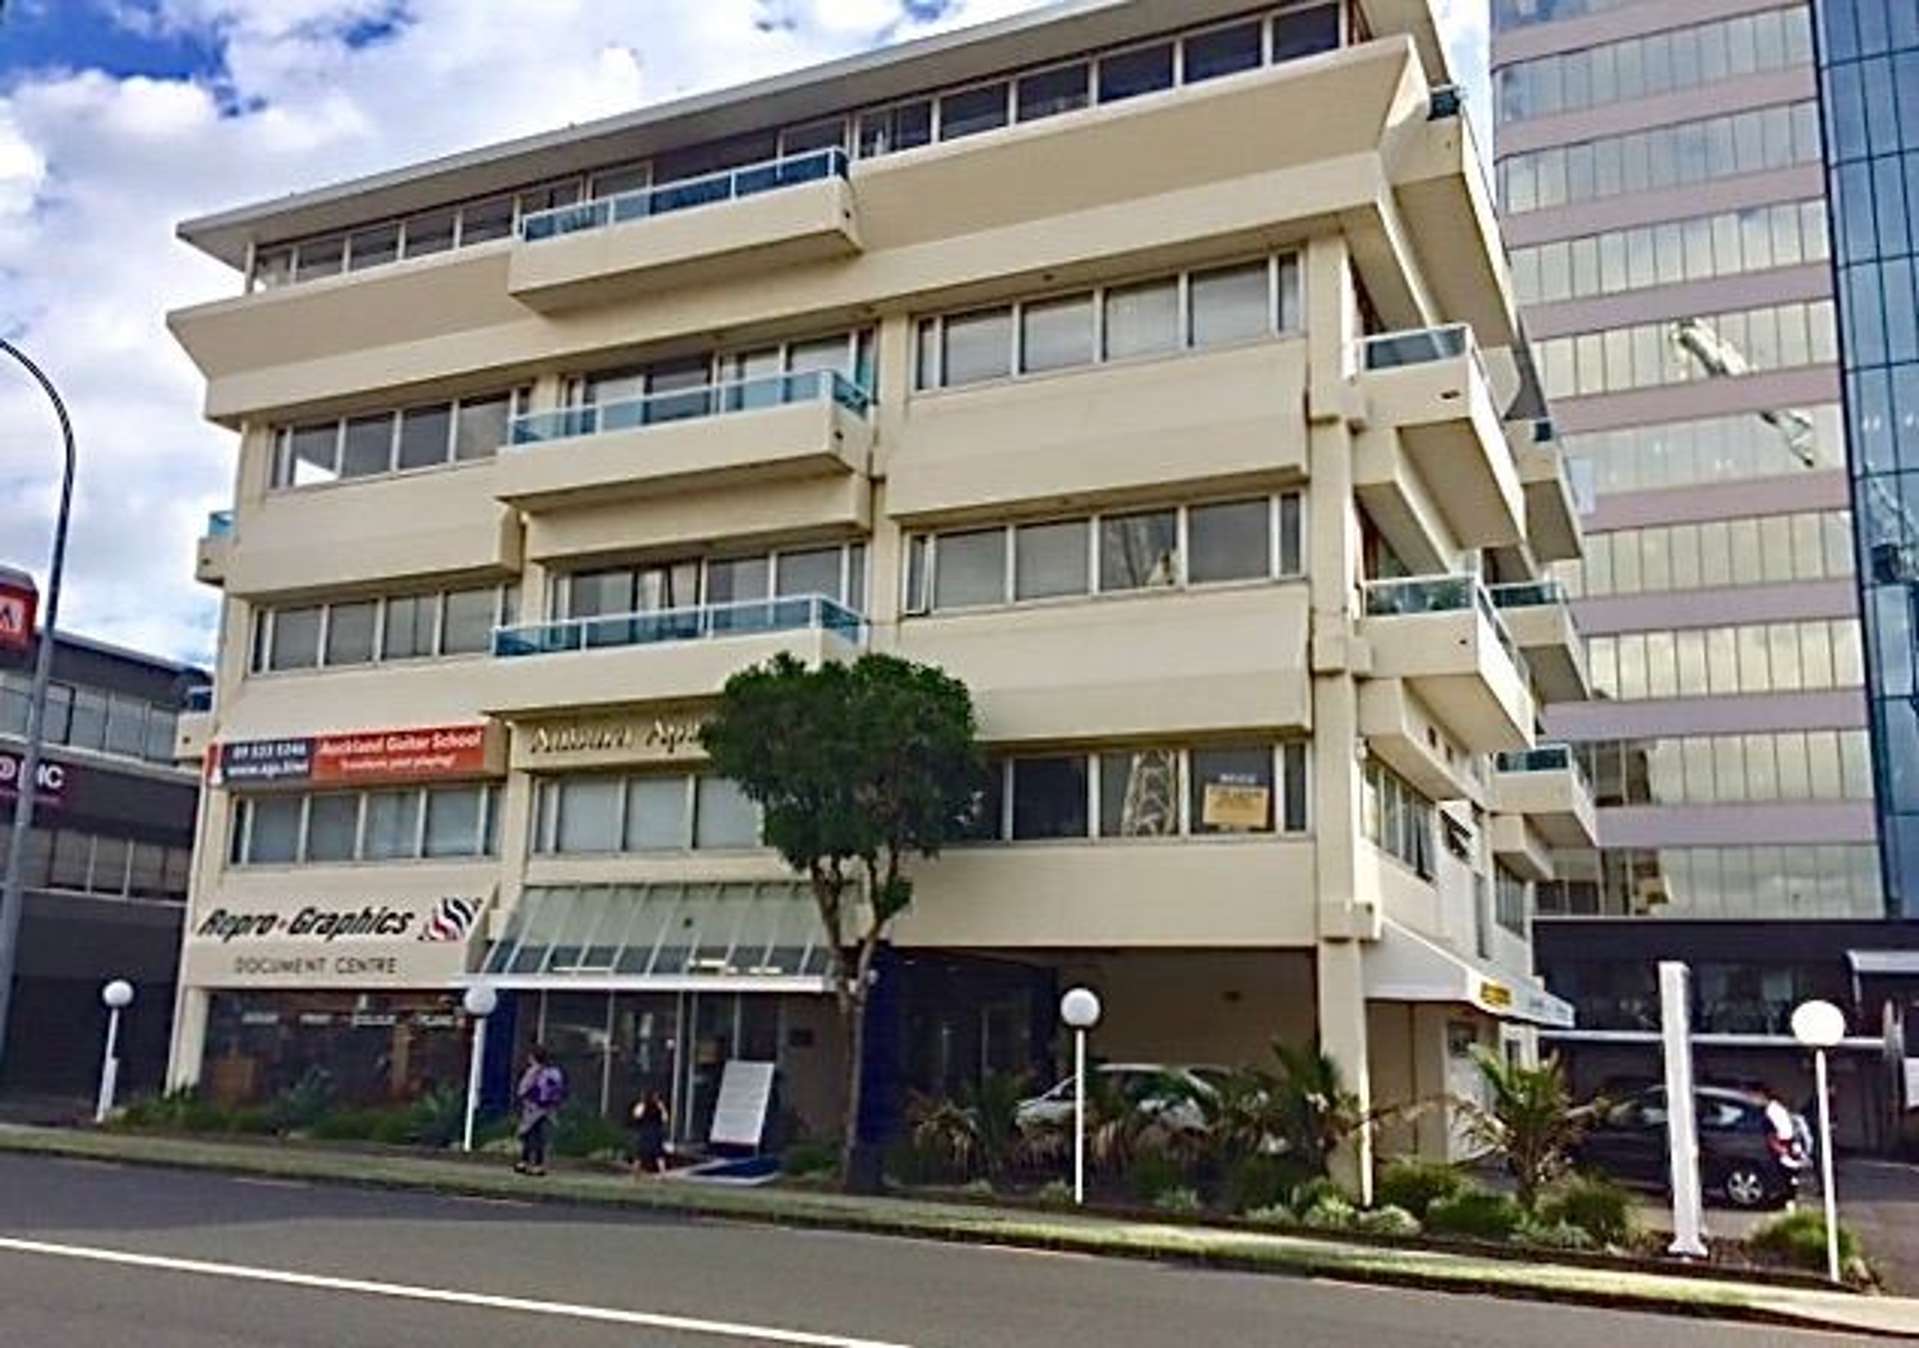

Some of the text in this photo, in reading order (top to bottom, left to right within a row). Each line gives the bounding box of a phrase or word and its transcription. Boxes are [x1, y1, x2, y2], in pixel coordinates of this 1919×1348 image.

[319, 730, 482, 753] Auckland Guitar School
[234, 956, 398, 975] DOCUMENT CENTRE
